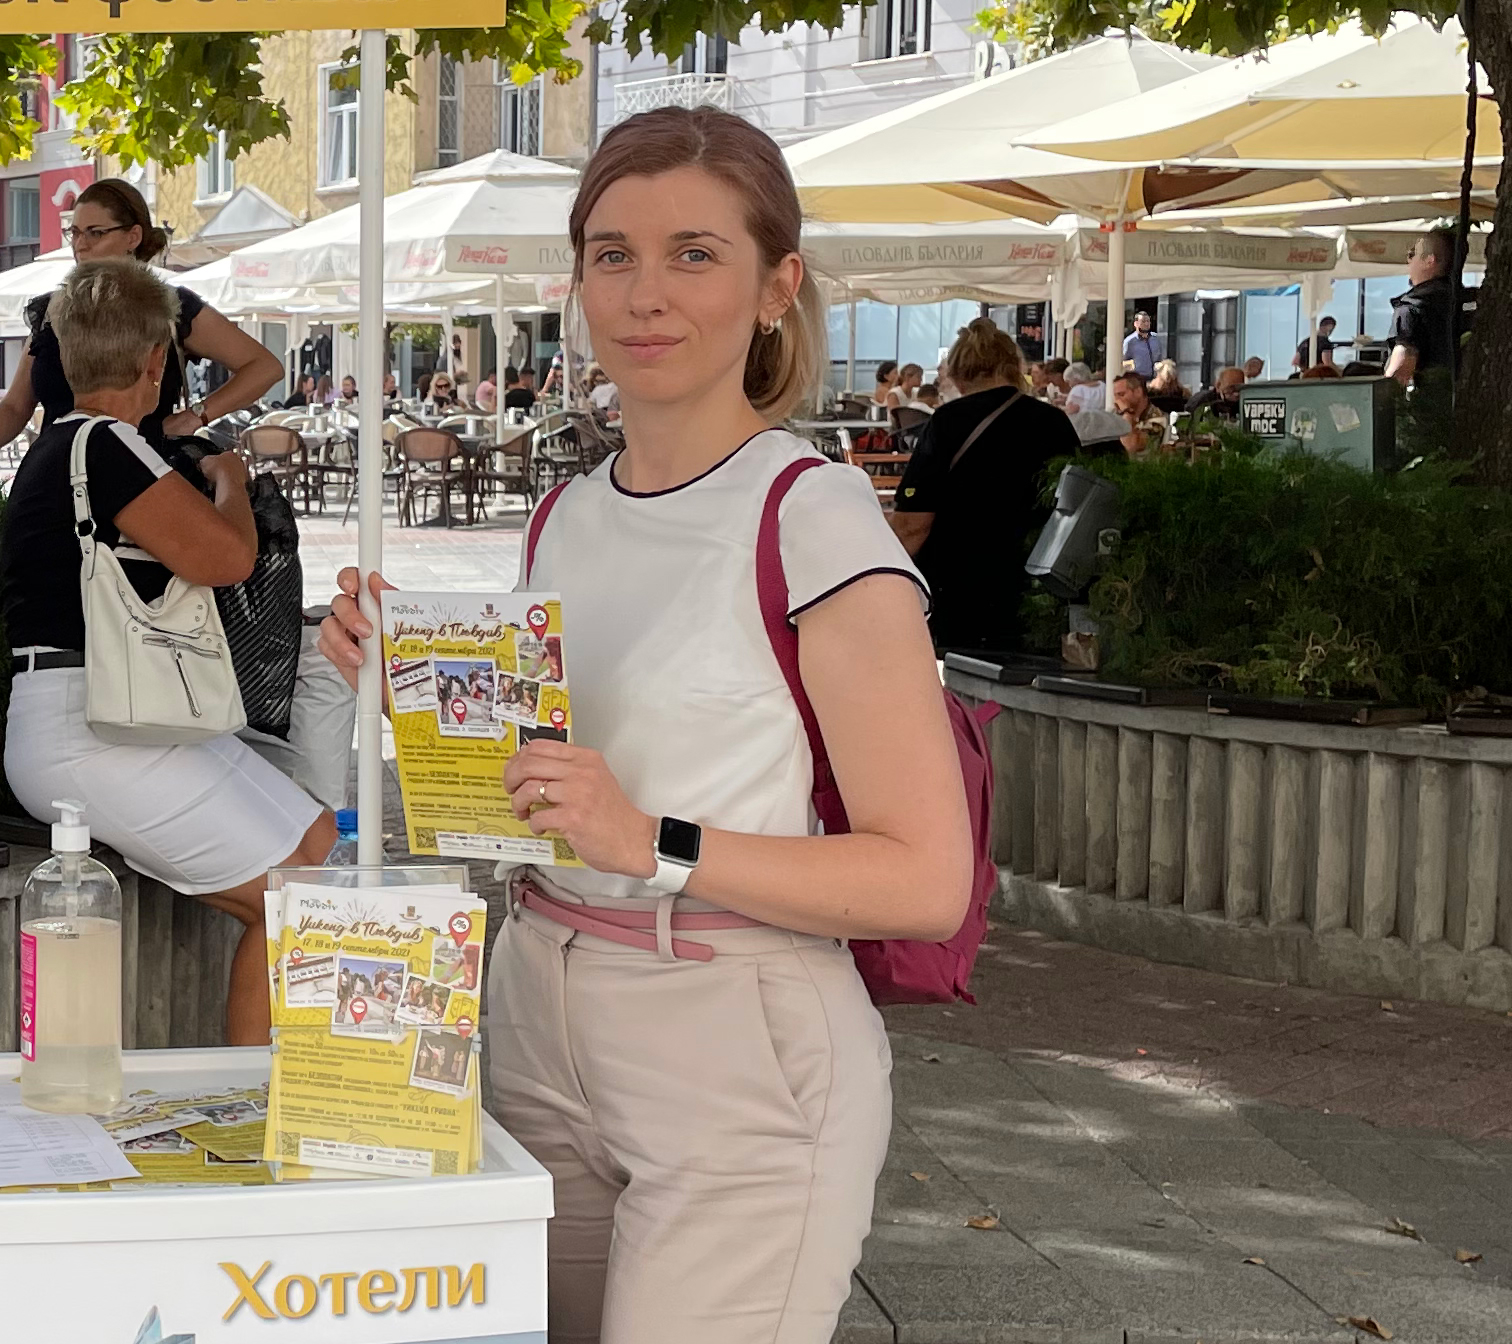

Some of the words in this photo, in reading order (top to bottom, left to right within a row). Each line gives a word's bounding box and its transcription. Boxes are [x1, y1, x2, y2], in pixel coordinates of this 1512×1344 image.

[918, 244, 984, 262] БЪЛГАРИЯ
[392, 620, 435, 643] Уикенд
[436, 623, 447, 637] в
[448, 622, 503, 643] Пловдив
[477, 646, 496, 656] 2021
[296, 914, 346, 938] Уикенд
[349, 921, 361, 935] в
[362, 921, 422, 944] Пловдив
[390, 946, 411, 957] 2021
[217, 1258, 489, 1324] Хотели
